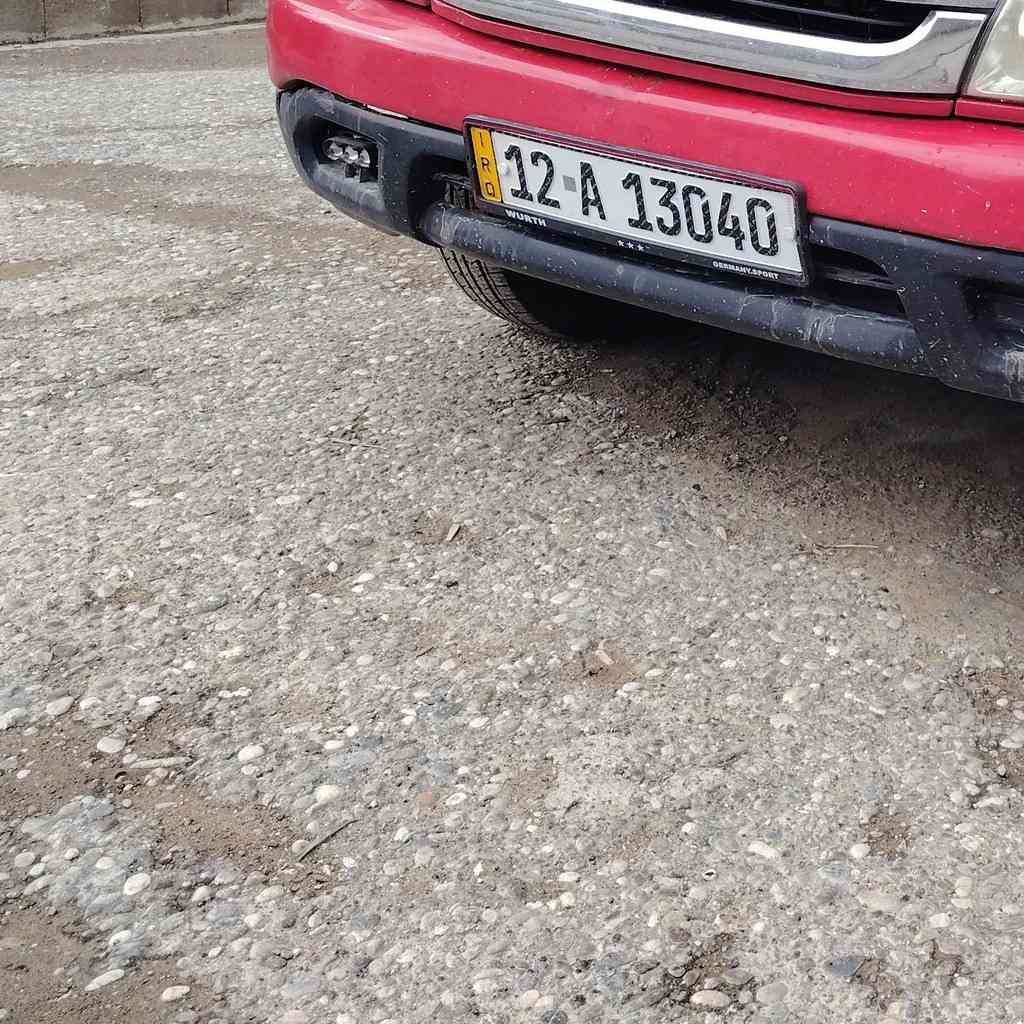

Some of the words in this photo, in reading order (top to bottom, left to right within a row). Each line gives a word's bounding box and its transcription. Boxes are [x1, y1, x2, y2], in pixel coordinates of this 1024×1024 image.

[505, 144, 561, 209] 12
[580, 161, 606, 221] A
[622, 172, 778, 257] 13040
